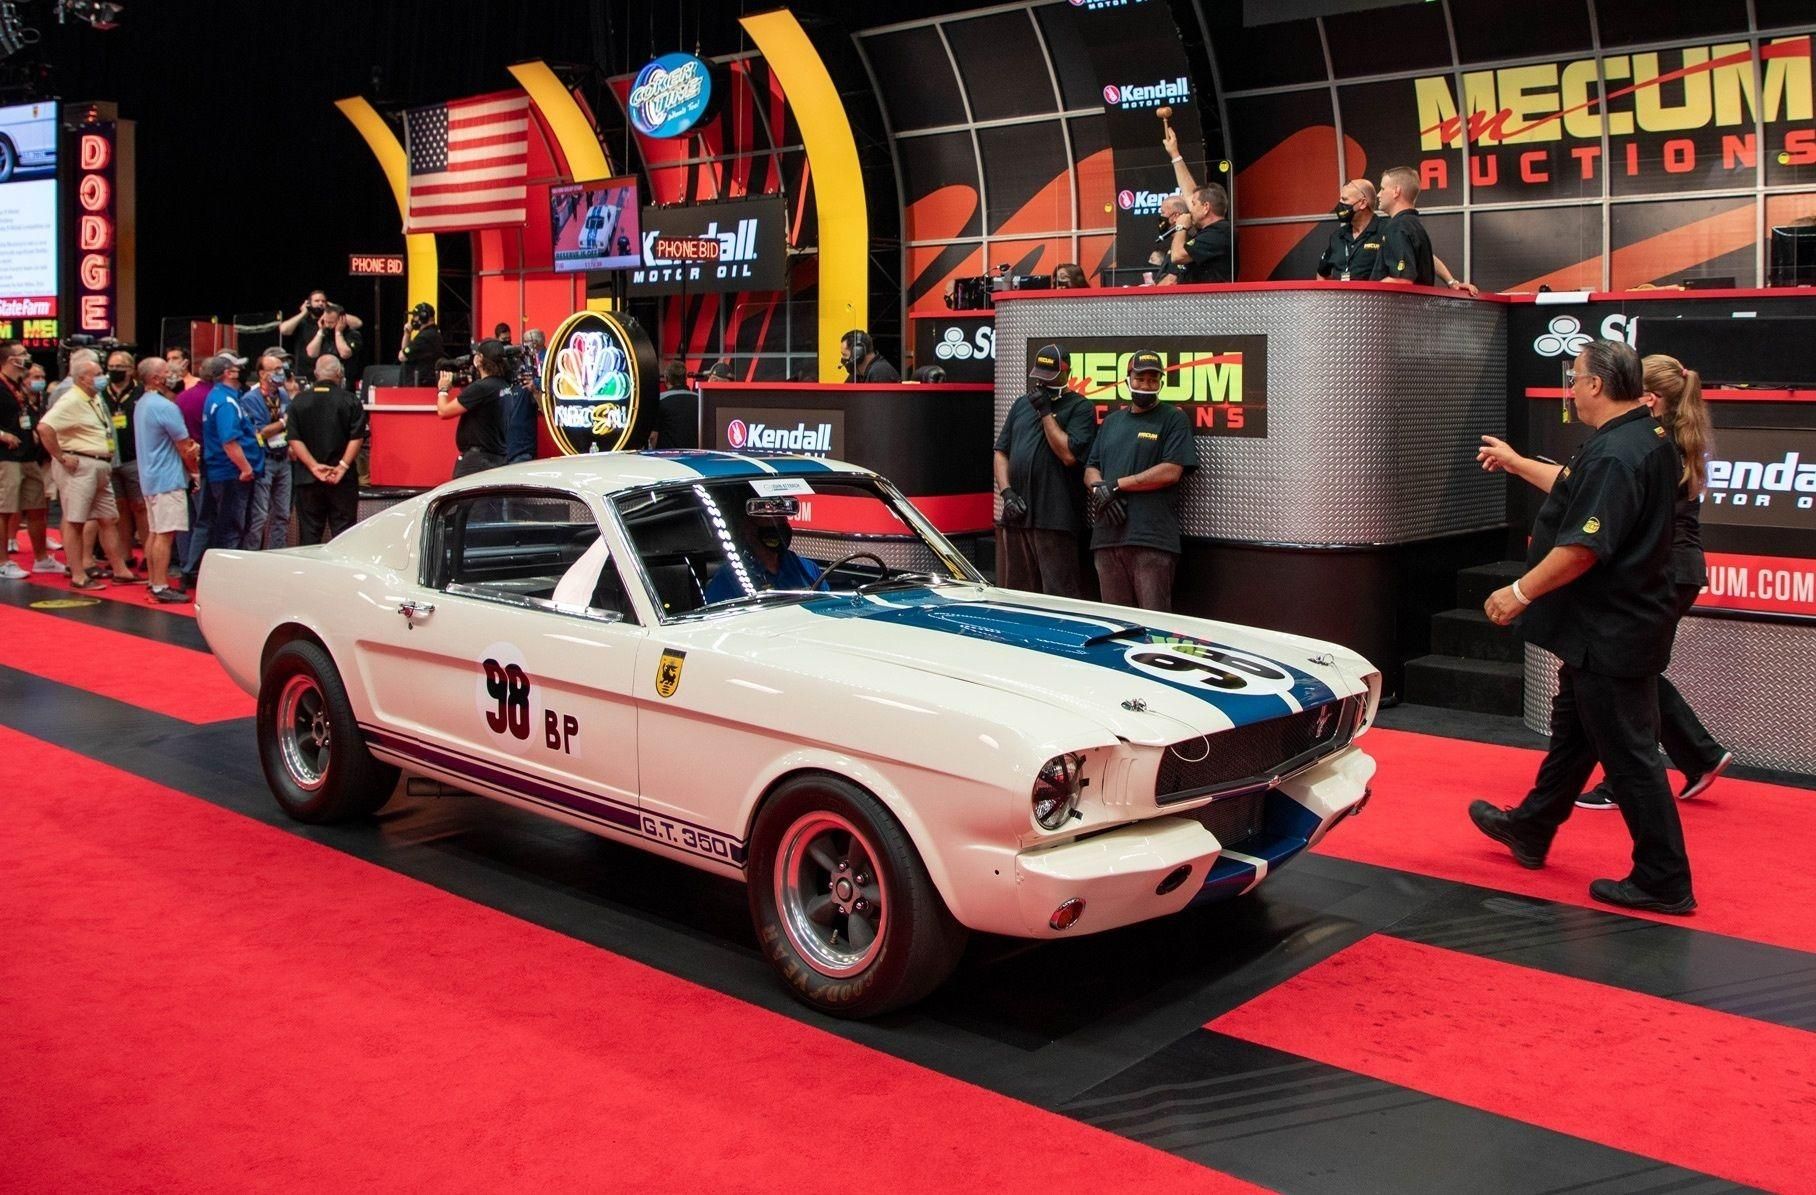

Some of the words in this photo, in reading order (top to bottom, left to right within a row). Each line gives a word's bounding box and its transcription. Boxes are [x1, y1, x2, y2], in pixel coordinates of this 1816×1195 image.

[1120, 77, 1189, 102] Kendall
[1122, 99, 1161, 109] MOTOR
[1169, 96, 1189, 104] OIL
[1414, 35, 1814, 151] MECUM
[1420, 129, 1816, 190] AUCTIONS
[80, 134, 111, 331] DODGE
[657, 240, 698, 258] PHONE
[699, 241, 719, 258] BID
[352, 257, 386, 273] PHONE
[387, 258, 403, 274] BID
[716, 264, 752, 278] OIL
[747, 422, 832, 450] Kendall
[1699, 492, 1771, 507] TOR
[1699, 565, 1814, 603] UM.COM
[1131, 644, 1286, 690] 98
[482, 658, 531, 740] 98
[545, 709, 579, 755] BP
[642, 816, 678, 843] G.T.
[681, 827, 729, 858] 350
